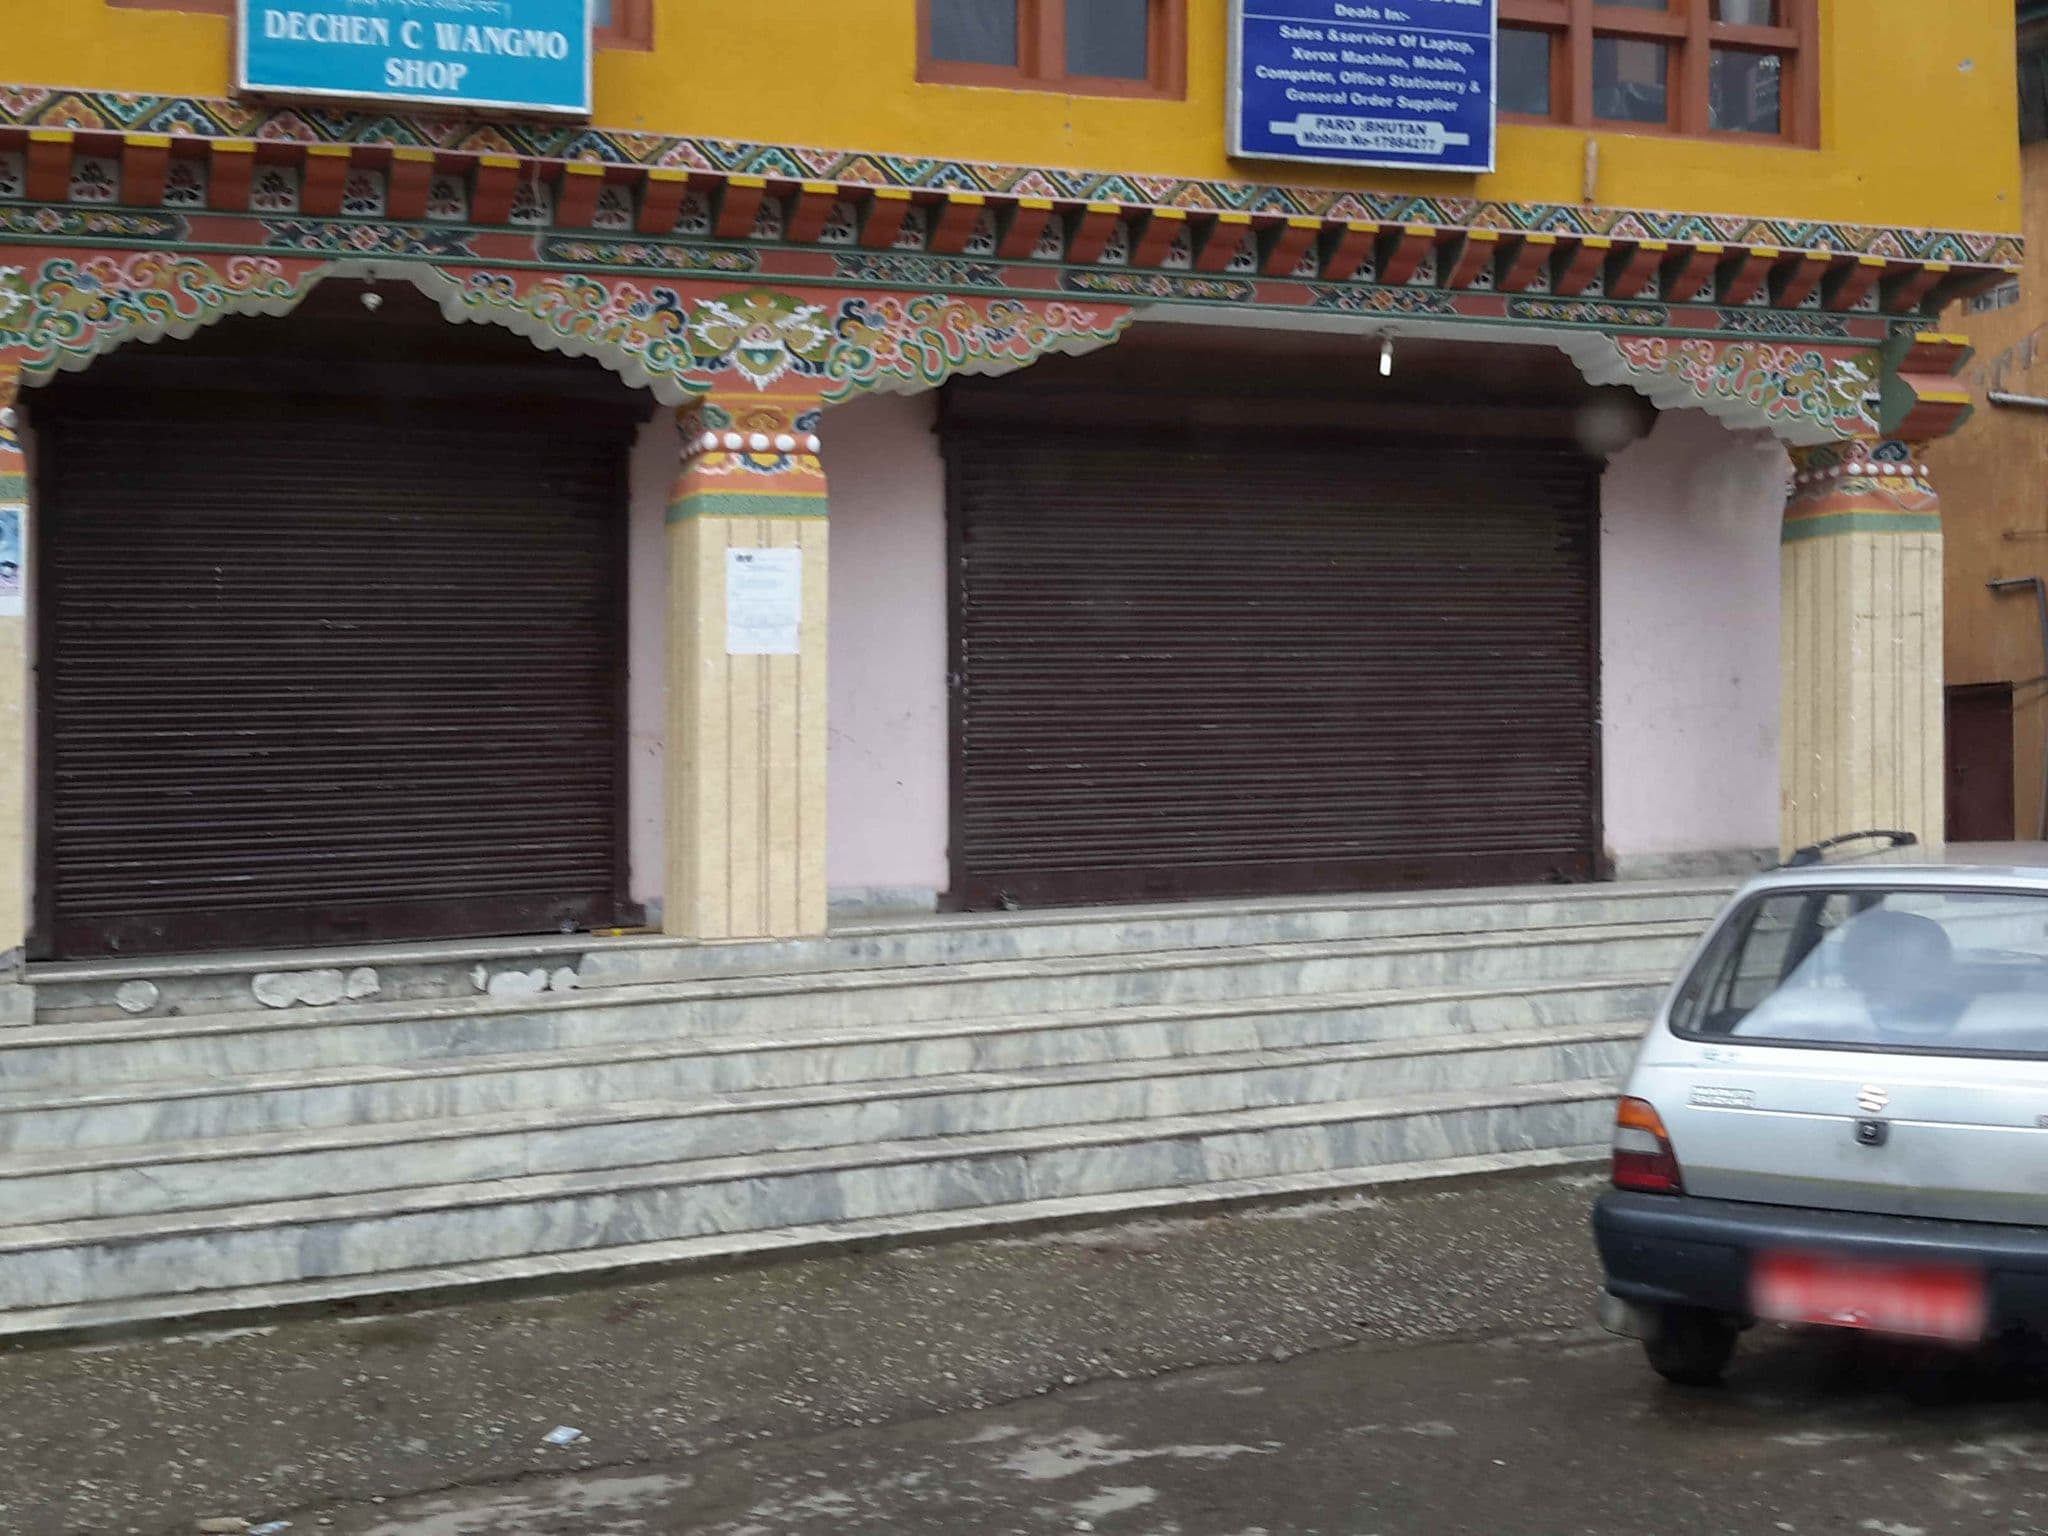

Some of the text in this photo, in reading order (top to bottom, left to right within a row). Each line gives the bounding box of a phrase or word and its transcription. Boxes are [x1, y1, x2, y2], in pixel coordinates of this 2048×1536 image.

[1334, 3, 1380, 19] Deals
[264, 9, 569, 60] DECHEN C WANGMO
[1279, 24, 1323, 41] Sales
[1400, 35, 1417, 48] Of
[1291, 47, 1338, 62] Xerox
[384, 57, 468, 90] SHOP
[1339, 71, 1386, 86] Office
[1469, 80, 1481, 93] &
[1285, 87, 1459, 112] General Order Supplier
[1315, 117, 1355, 131] PARO
[1302, 131, 1347, 145] Mobile
